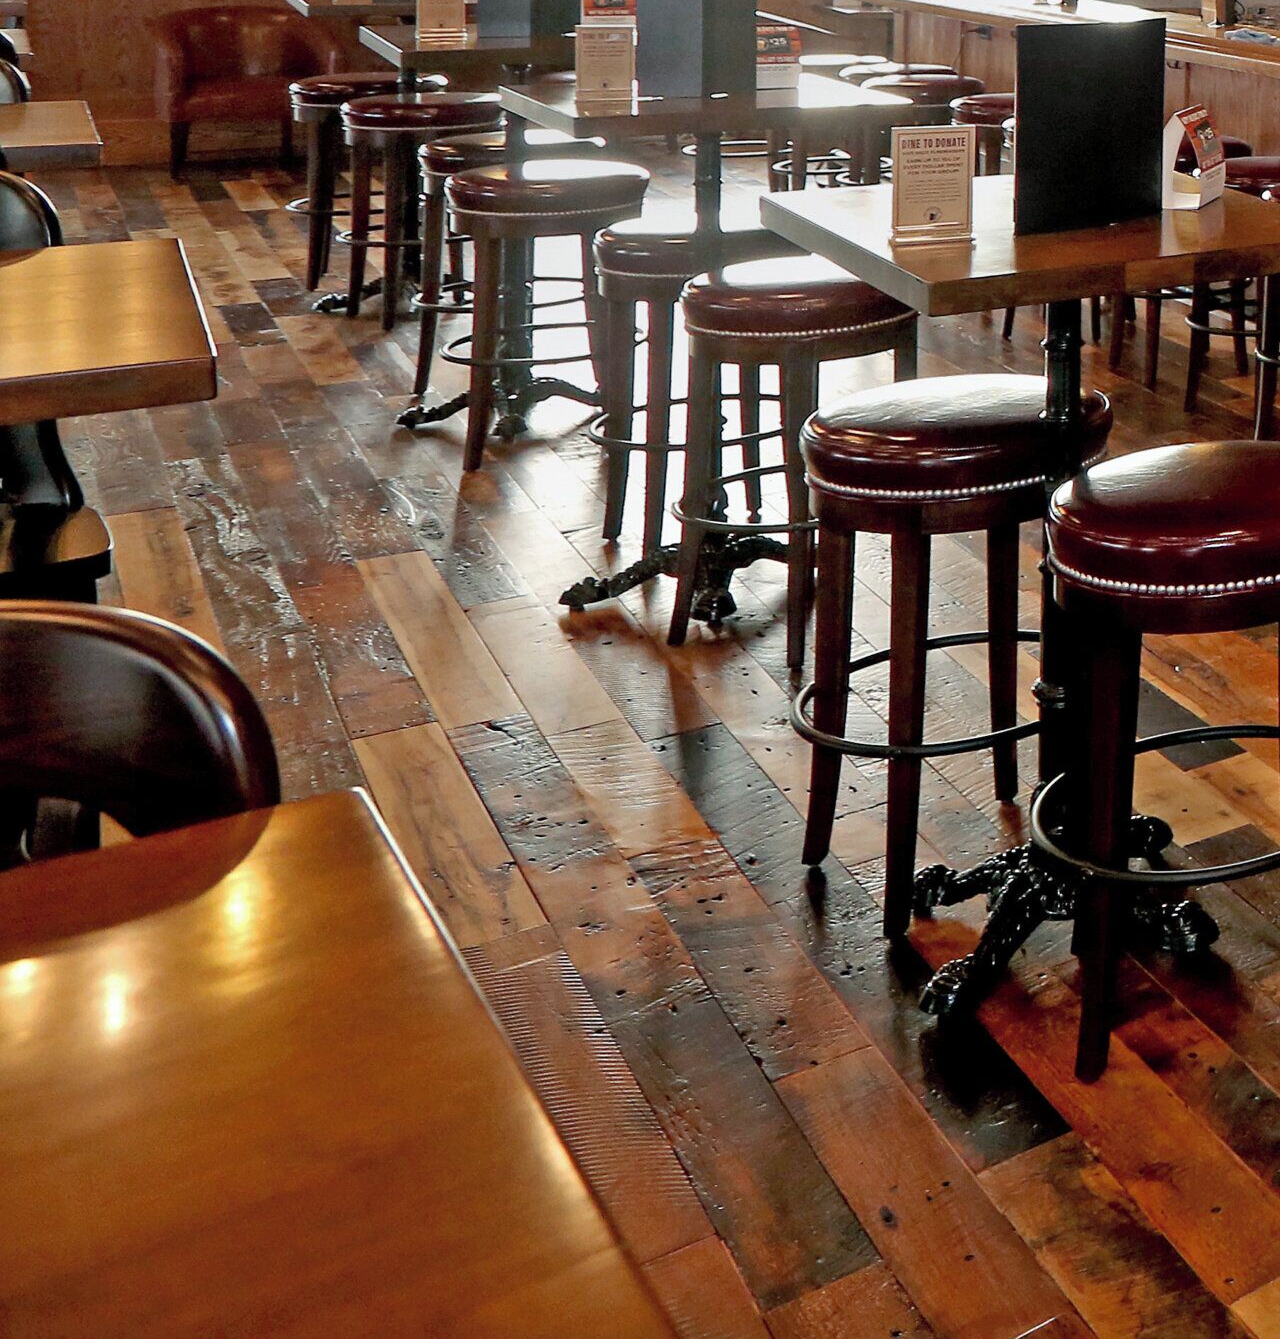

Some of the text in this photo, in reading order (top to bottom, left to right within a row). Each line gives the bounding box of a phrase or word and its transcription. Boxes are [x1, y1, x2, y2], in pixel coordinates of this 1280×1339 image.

[901, 136, 966, 150] DINE TO DONATE
